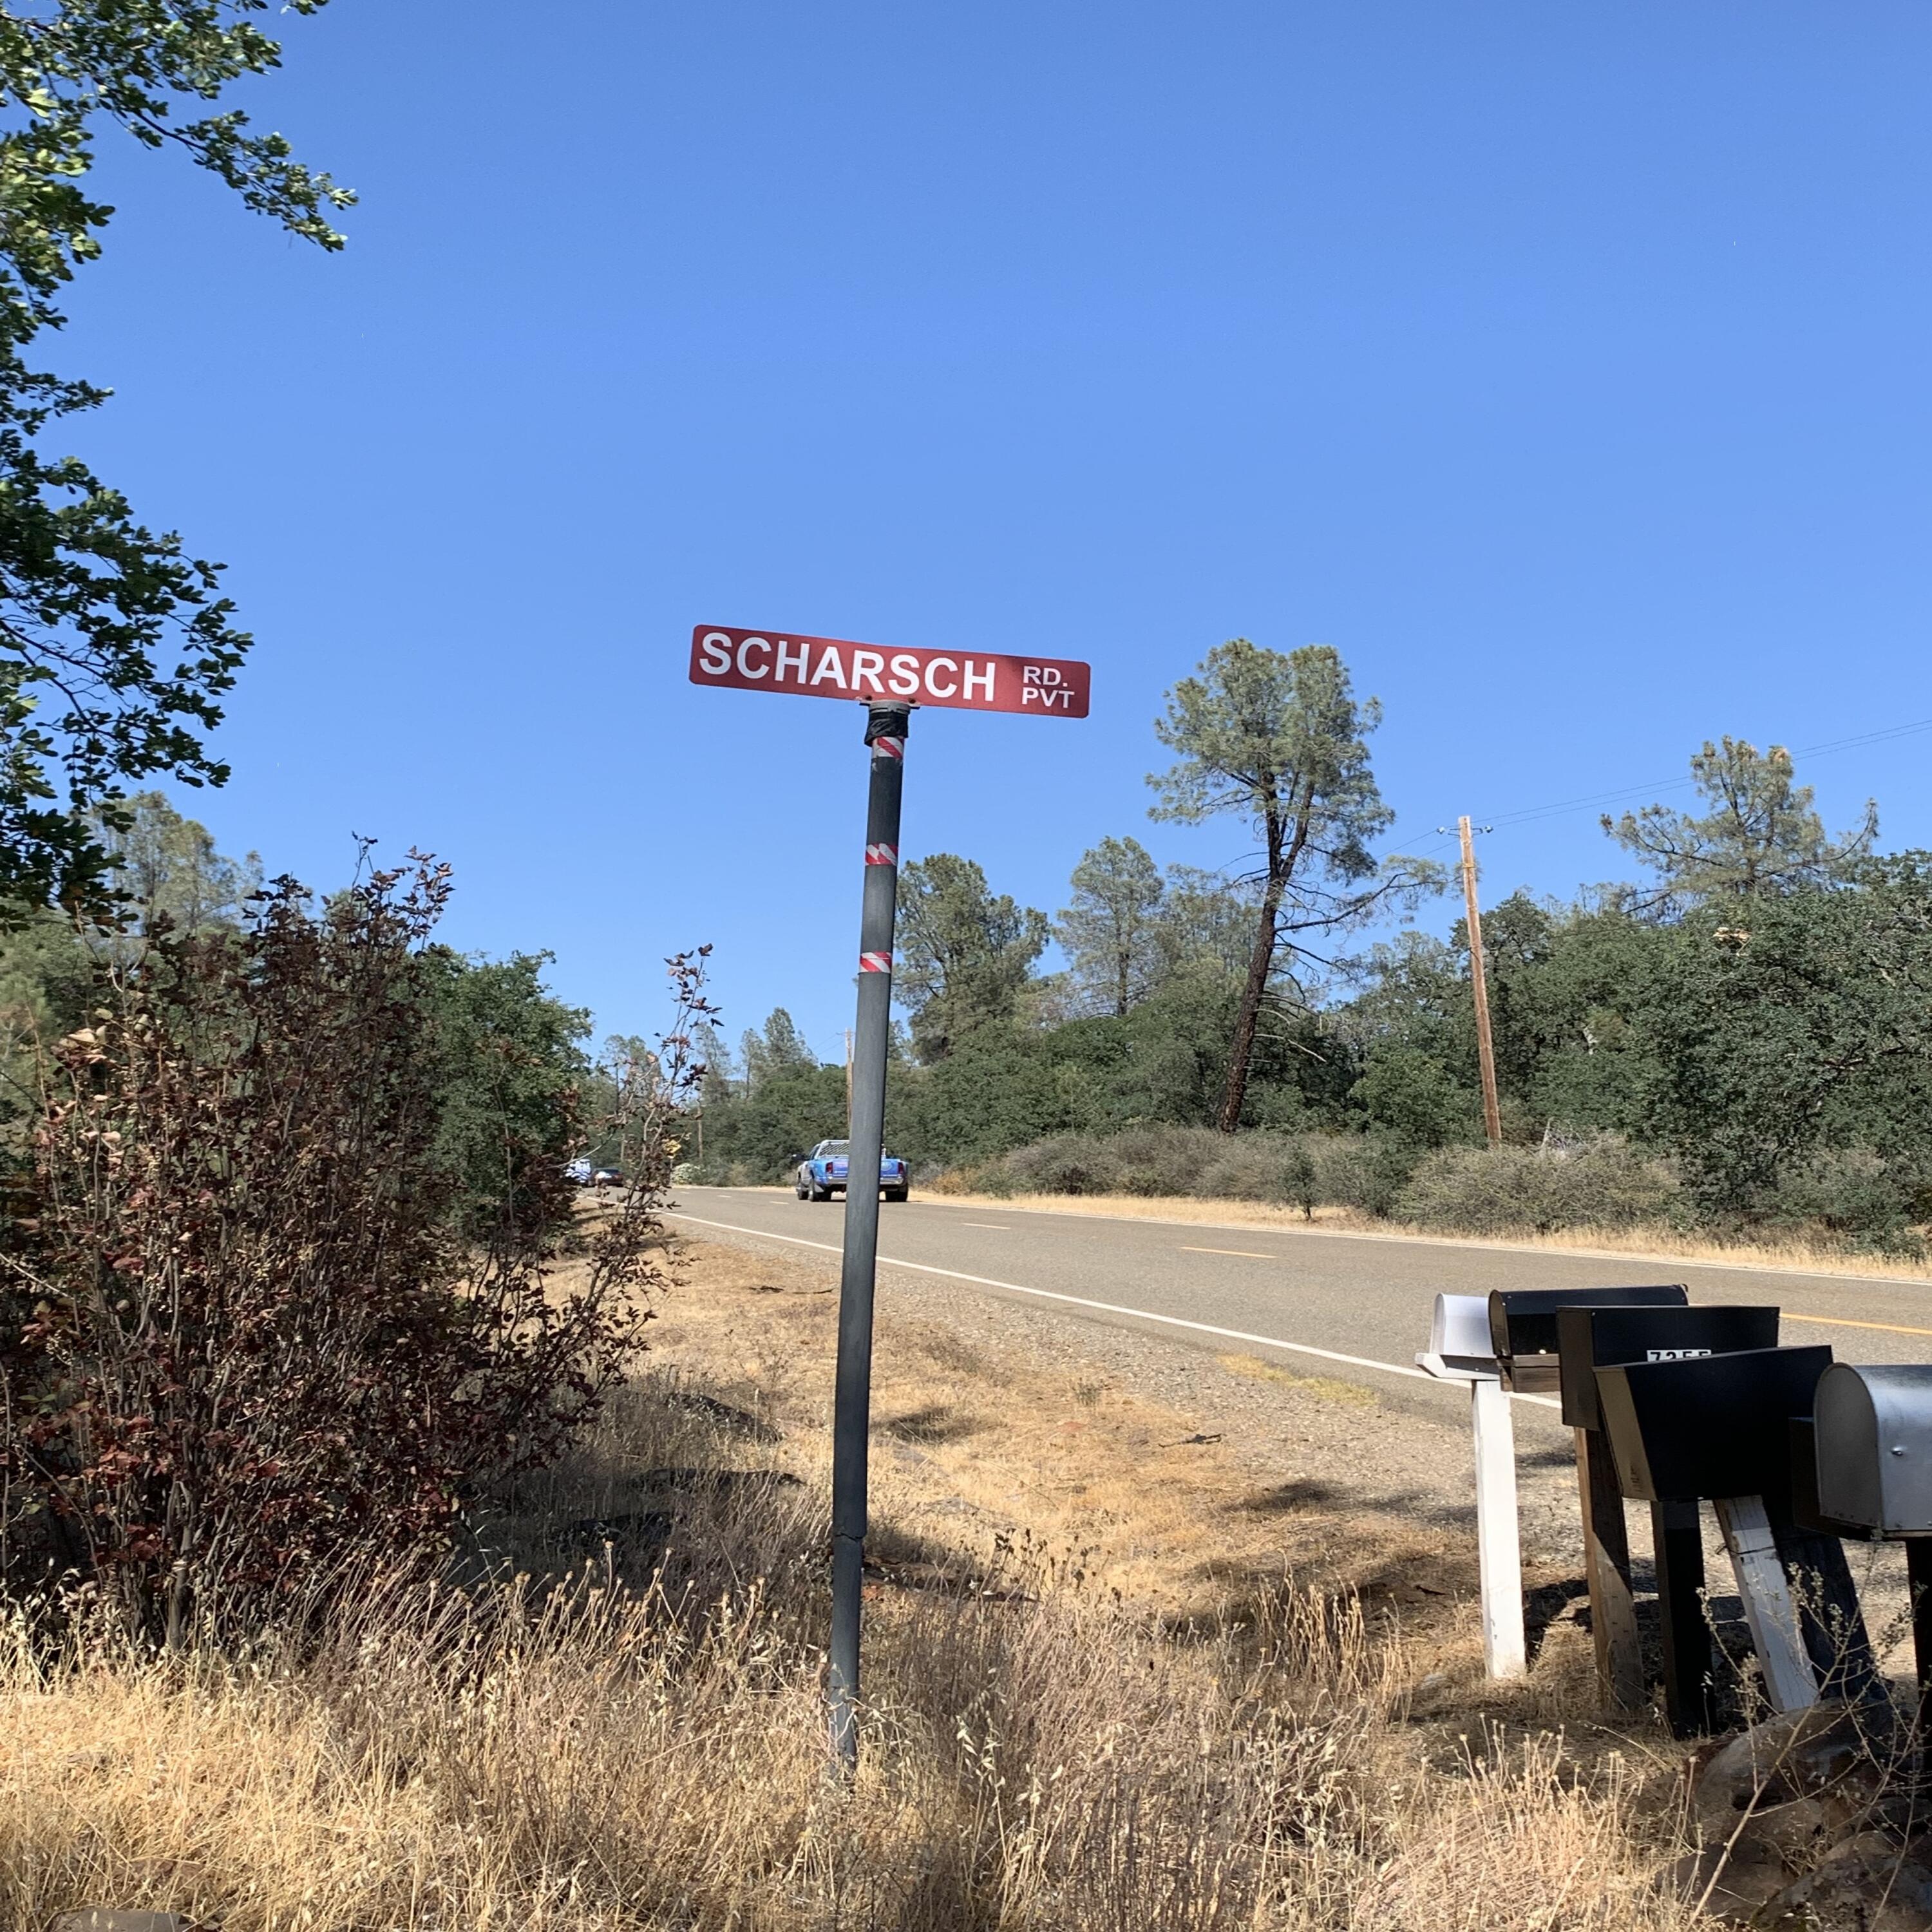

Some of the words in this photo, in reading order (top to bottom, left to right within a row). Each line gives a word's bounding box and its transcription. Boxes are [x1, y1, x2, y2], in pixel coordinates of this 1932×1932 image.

[699, 632, 996, 703] SCHARSCH
[1022, 665, 1068, 687] RD.
[1021, 687, 1075, 708] PVT
